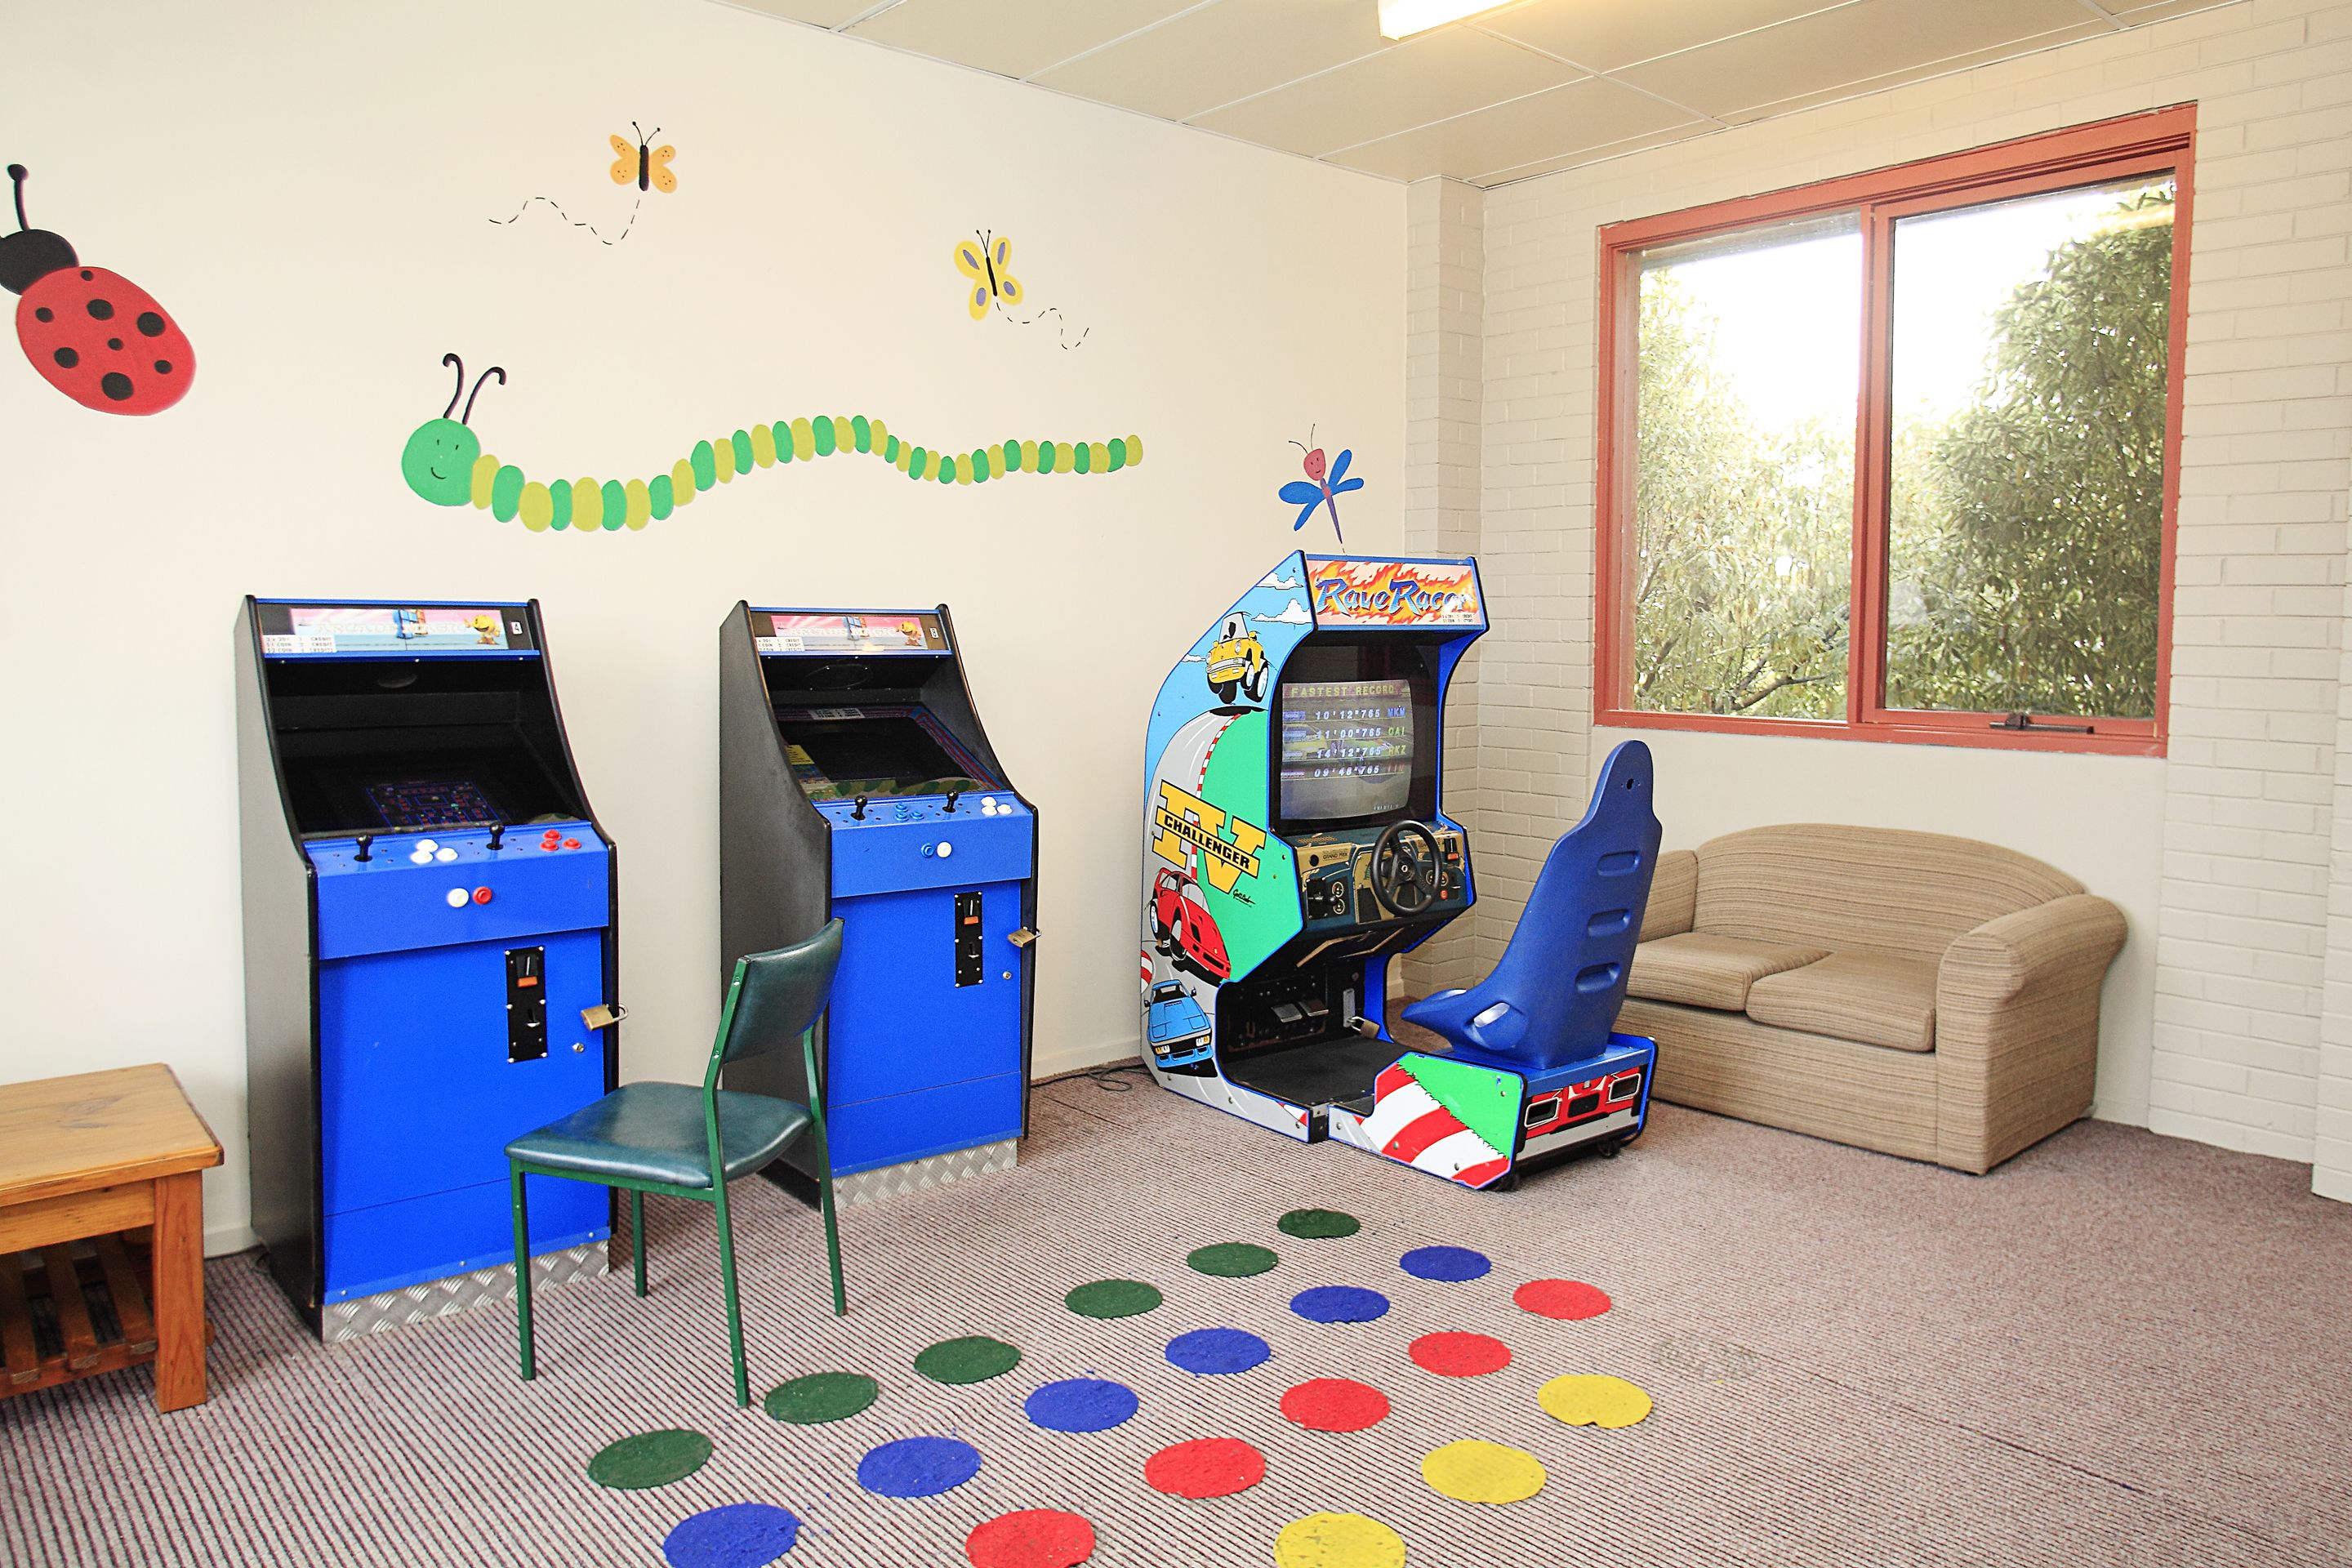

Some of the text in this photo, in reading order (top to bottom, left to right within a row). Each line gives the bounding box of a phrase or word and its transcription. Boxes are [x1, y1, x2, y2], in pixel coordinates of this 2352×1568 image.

[1316, 577, 1390, 617] Rave
[790, 626, 847, 635] ARCADE
[1291, 684, 1395, 697] FASTEST RECORD
[1164, 814, 1250, 870] CHALLENGER
